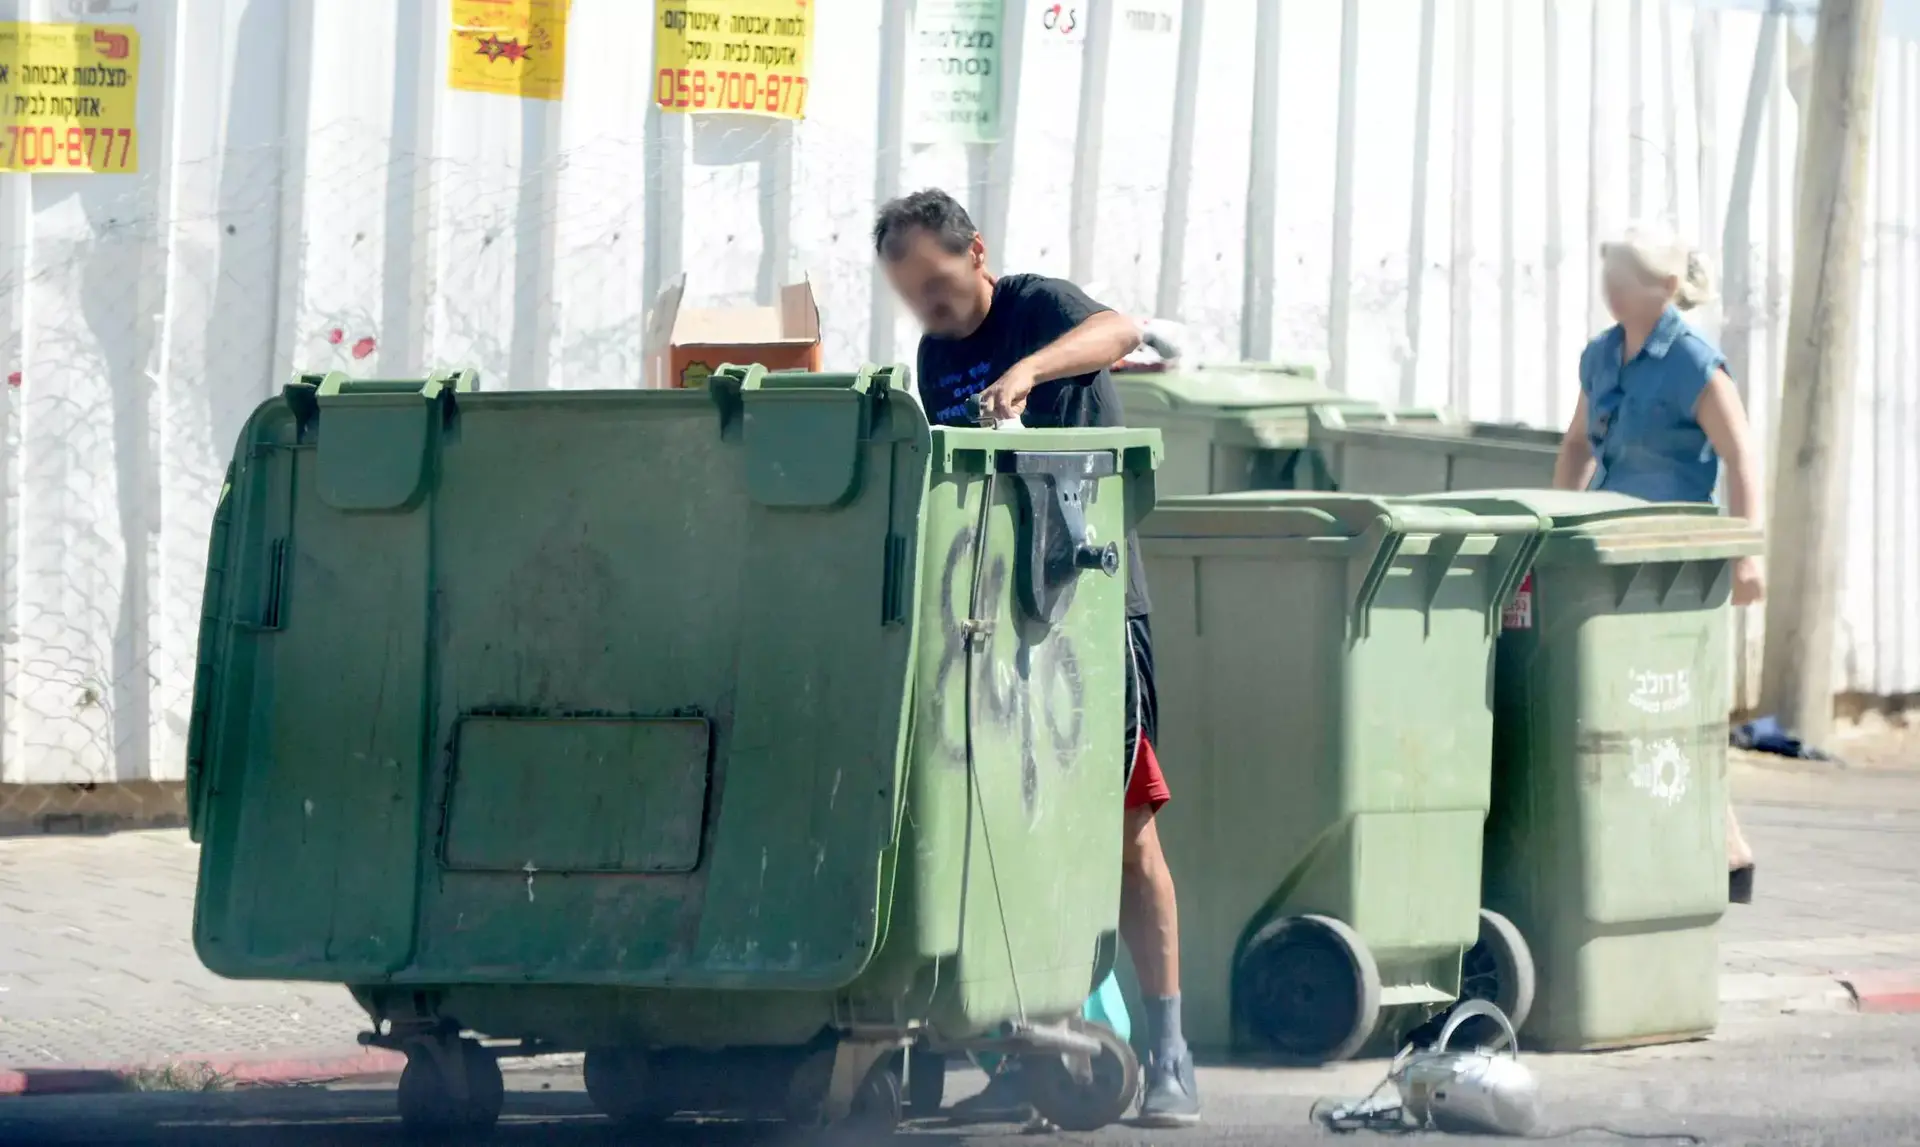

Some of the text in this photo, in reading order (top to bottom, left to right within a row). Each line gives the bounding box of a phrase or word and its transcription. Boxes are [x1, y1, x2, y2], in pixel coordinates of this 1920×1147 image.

[664, 10, 720, 35] אינטרקום
[730, 15, 770, 35] אבטחה
[723, 40, 750, 62] לבית
[753, 44, 796, 69] אזעקות
[22, 64, 68, 86] אבטחה
[73, 62, 127, 87] מצלמות
[14, 91, 101, 122] אזעקות לבית
